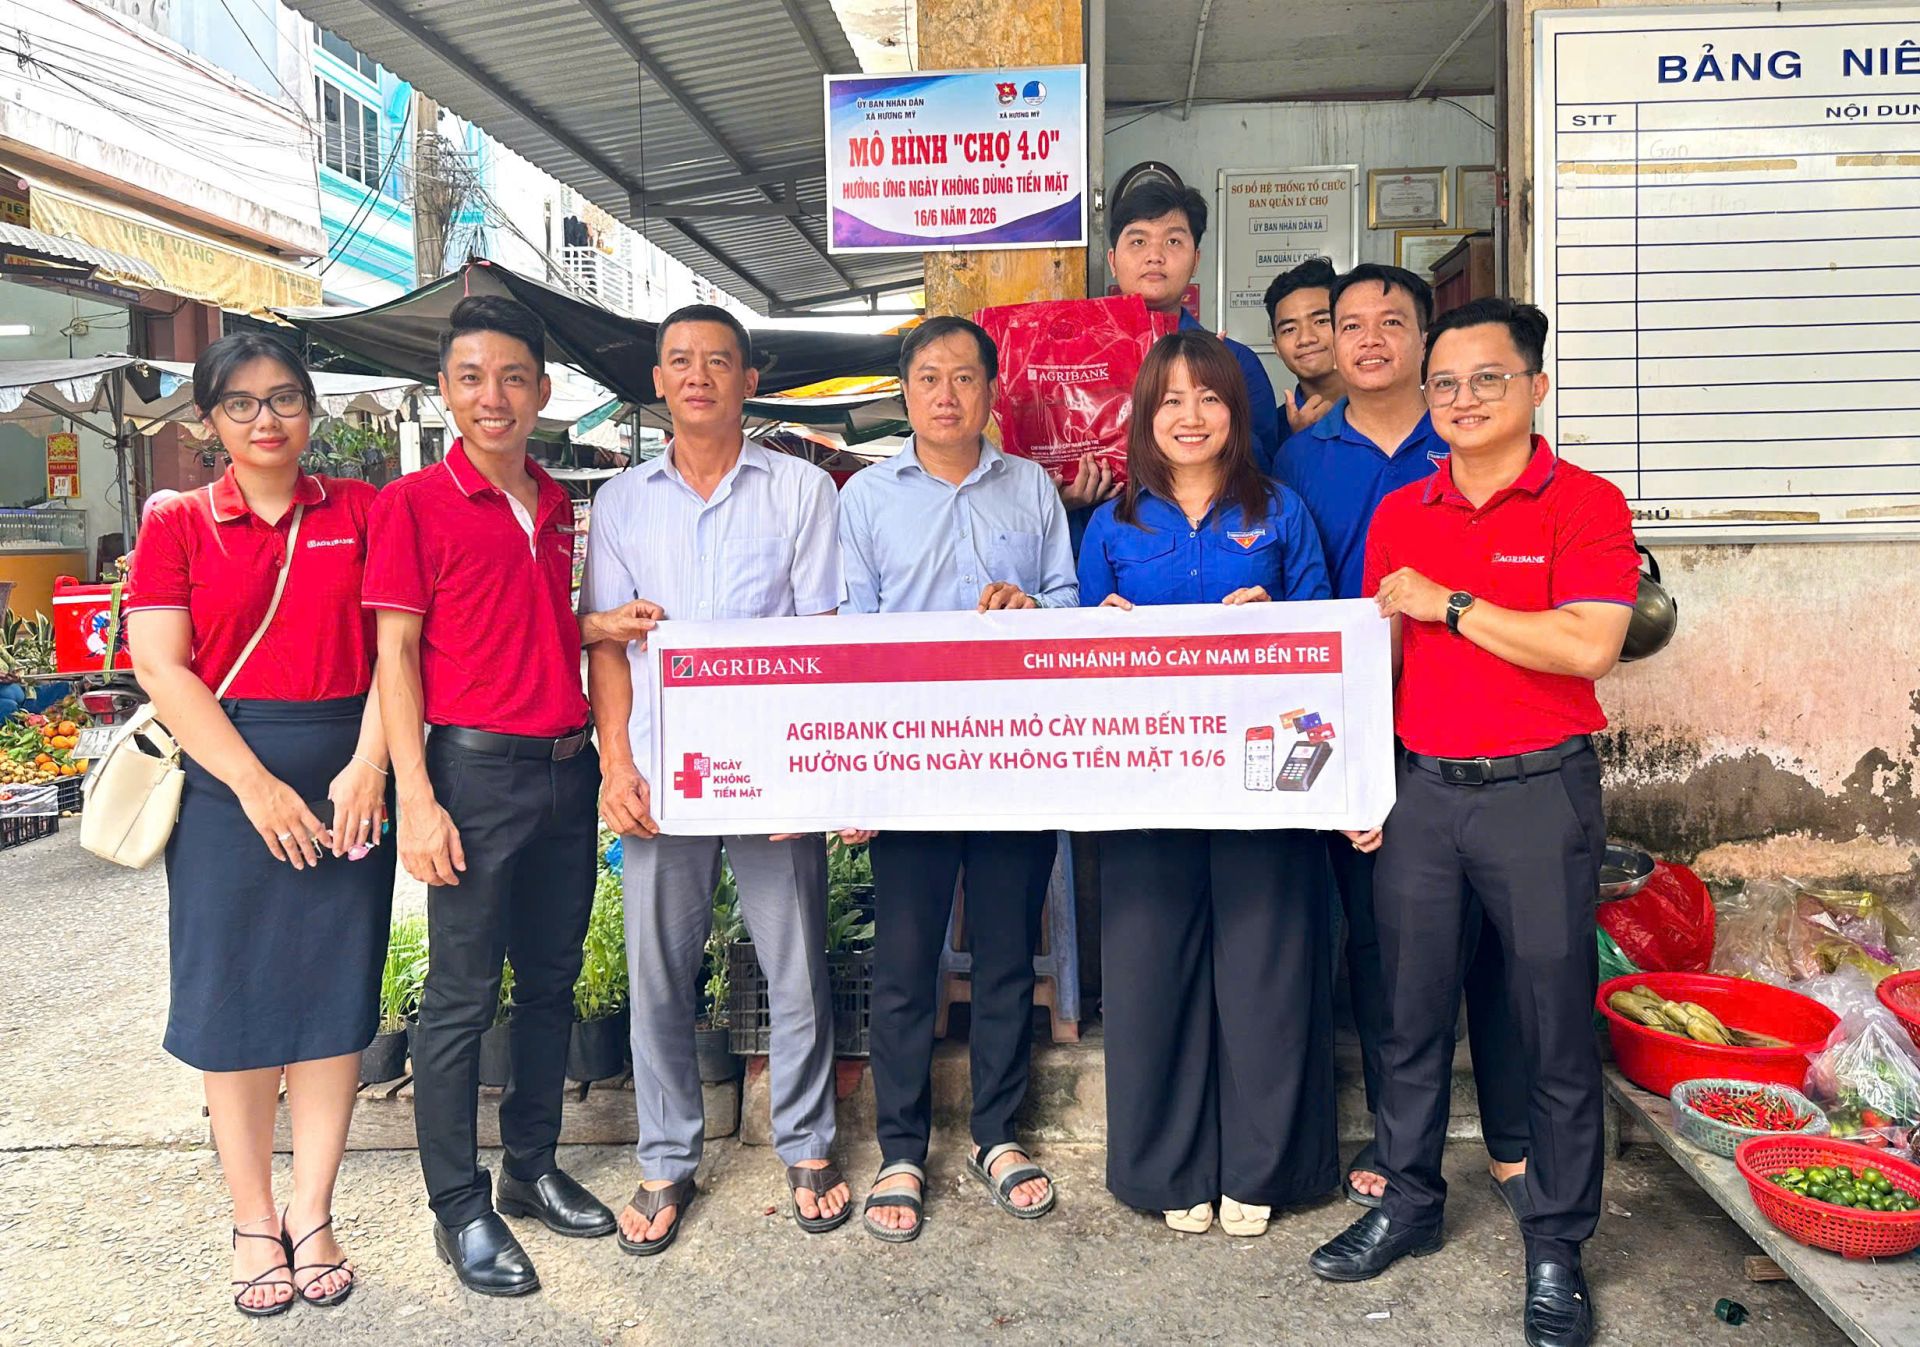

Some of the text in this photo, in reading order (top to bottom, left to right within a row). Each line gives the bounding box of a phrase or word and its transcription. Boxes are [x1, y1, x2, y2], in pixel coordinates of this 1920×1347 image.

[1658, 40, 1920, 83] BẢNG NIÊ
[869, 100, 884, 108] BAN
[886, 97, 906, 107] NHÂN
[908, 96, 924, 106] DÂN
[877, 111, 902, 120] HƯƠNG
[1825, 103, 1920, 121] NỘI DUN
[1572, 114, 1617, 127] STT
[849, 129, 1060, 168] MÔ HÌNH "CHỢ 4.0"
[842, 176, 880, 199] HƯỞNG
[883, 174, 905, 198] ỨNG
[909, 175, 938, 197] NGÀY
[941, 175, 979, 196] KHÔNG
[982, 173, 1013, 194] DÙNG
[1045, 171, 1069, 196] MẶT
[1231, 179, 1346, 194] SƠ ĐỒ HỆ THỐNG TỔ CHỨC
[1249, 194, 1328, 208] BAN QUẢN LÝ CHỢ
[914, 205, 997, 227] 16/6 NĂM 2026
[1264, 223, 1277, 231] BAN
[1279, 220, 1297, 230] NHÂN
[1299, 219, 1312, 230] DÂN
[1258, 255, 1271, 263] BAN
[1274, 252, 1291, 263] QUẢN
[1040, 367, 1109, 381] AGRIBANK
[1636, 506, 1670, 520] HÚ
[1499, 555, 1545, 564] AGRIBANK
[1023, 642, 1330, 669] CHI NHÁNH MỎ CÀY NAM BẾN TRE
[698, 656, 823, 677] AGRIBANK
[787, 710, 1227, 741] AGRIBANK CHI NHÁNH MỎ CÀY NAM BẾN TRE
[713, 758, 742, 771] NGÀY
[789, 750, 867, 773] HƯỞNG
[874, 750, 920, 771] ỨNG
[926, 749, 983, 770] NGÀY
[989, 746, 1068, 769] KHÔNG
[1072, 745, 1120, 768] TIỀN
[1127, 745, 1173, 772] MẶT
[1180, 749, 1226, 768] 16/6
[713, 773, 750, 784] KHÔNG
[739, 786, 763, 799] MẶT
